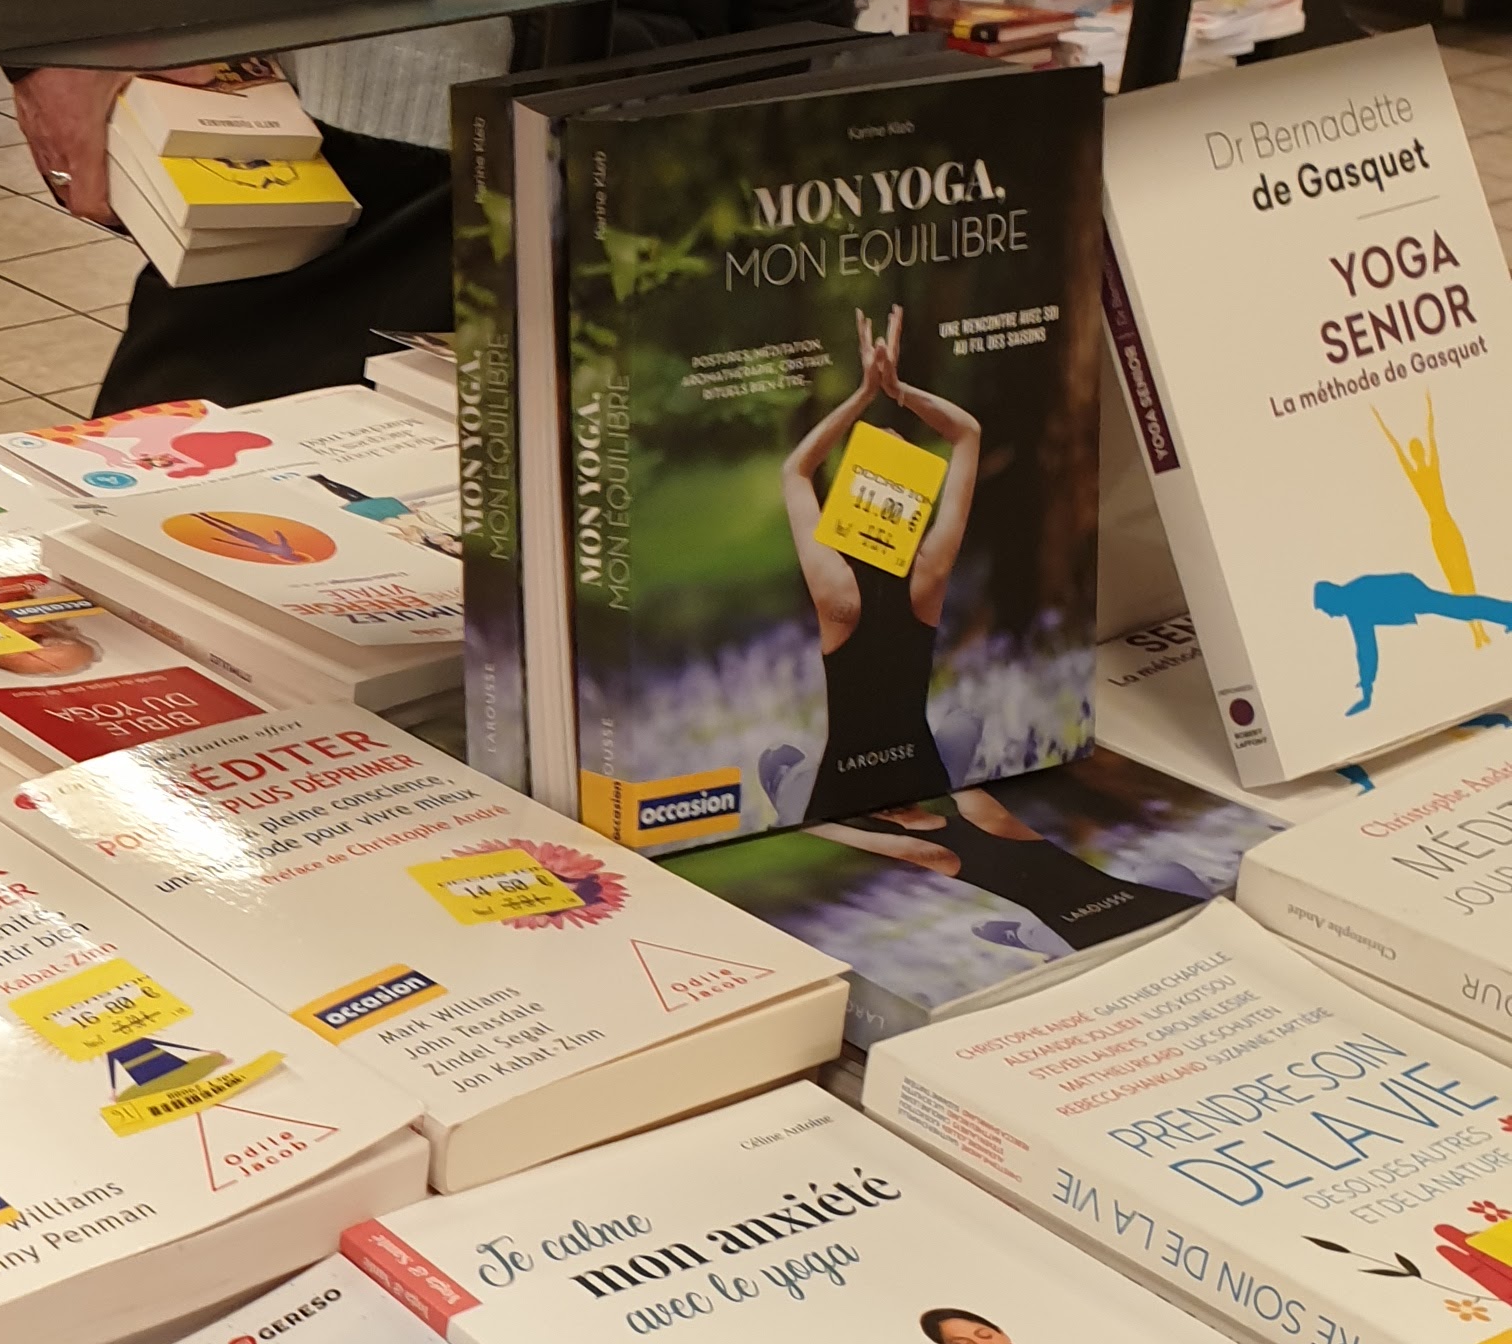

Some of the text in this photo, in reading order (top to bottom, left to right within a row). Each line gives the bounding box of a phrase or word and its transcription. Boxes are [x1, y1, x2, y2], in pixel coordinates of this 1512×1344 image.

[1206, 91, 1414, 172] Dr Bernadette
[751, 157, 1007, 231] MON YOGA,
[1252, 138, 1430, 214] de Gasquet
[725, 209, 1029, 293] MON ÉQUILIBRE
[1330, 228, 1460, 300] YOGA
[1319, 284, 1477, 366] SENIOR
[108, 711, 201, 737] BIBLE
[836, 741, 916, 774] LAROUSSE
[222, 752, 423, 816] PLUS DÉPRIMER
[639, 789, 738, 828] occasion
[323, 973, 424, 1029] occasion
[1107, 1072, 1316, 1159] PRENDRE
[1286, 1031, 1409, 1091] SOIN
[1167, 1060, 1500, 1207] DE LA VIE
[46, 1200, 158, 1251] Penman
[476, 1211, 652, 1290] Je calme
[568, 1166, 902, 1300] mon anxiété
[258, 1288, 342, 1341] GERESO
[626, 1239, 860, 1335] avec le yoga
